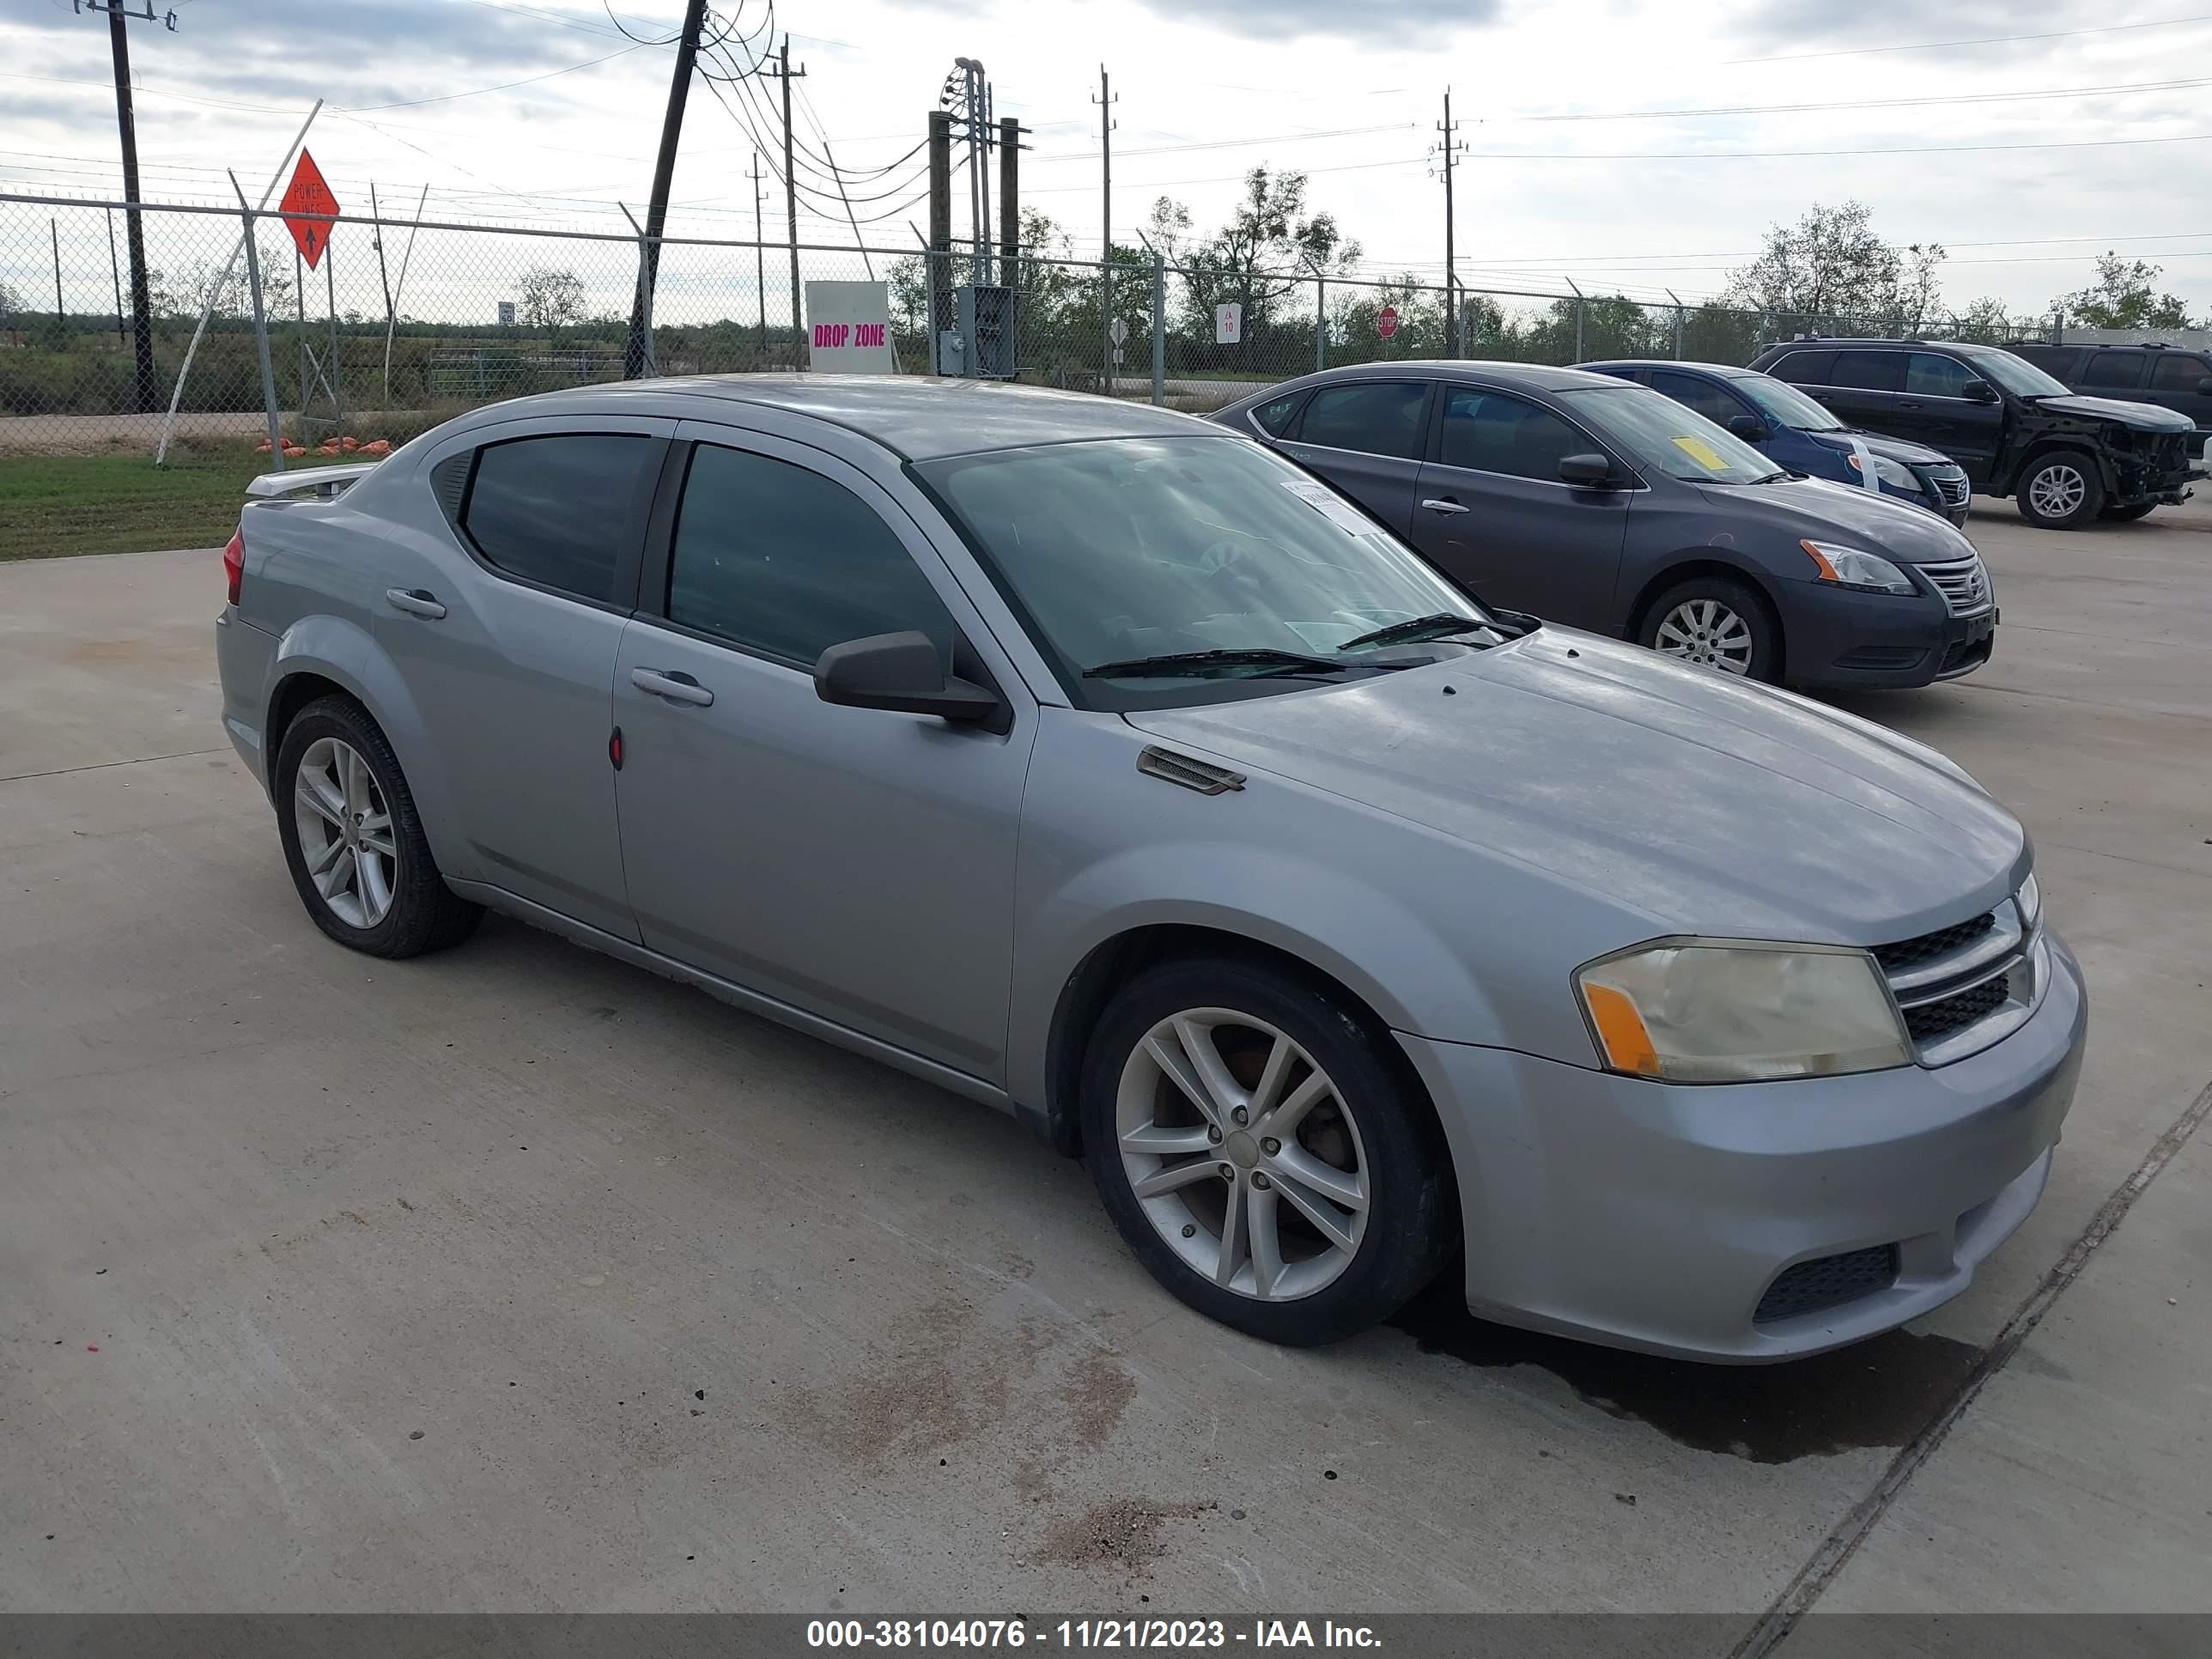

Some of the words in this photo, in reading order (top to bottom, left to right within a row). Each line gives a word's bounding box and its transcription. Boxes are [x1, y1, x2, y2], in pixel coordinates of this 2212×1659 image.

[294, 183, 323, 200] POWER
[1224, 322, 1234, 333] 10
[1379, 316, 1397, 327] STOP
[814, 324, 849, 349] DROP
[854, 324, 885, 348] ZONE
